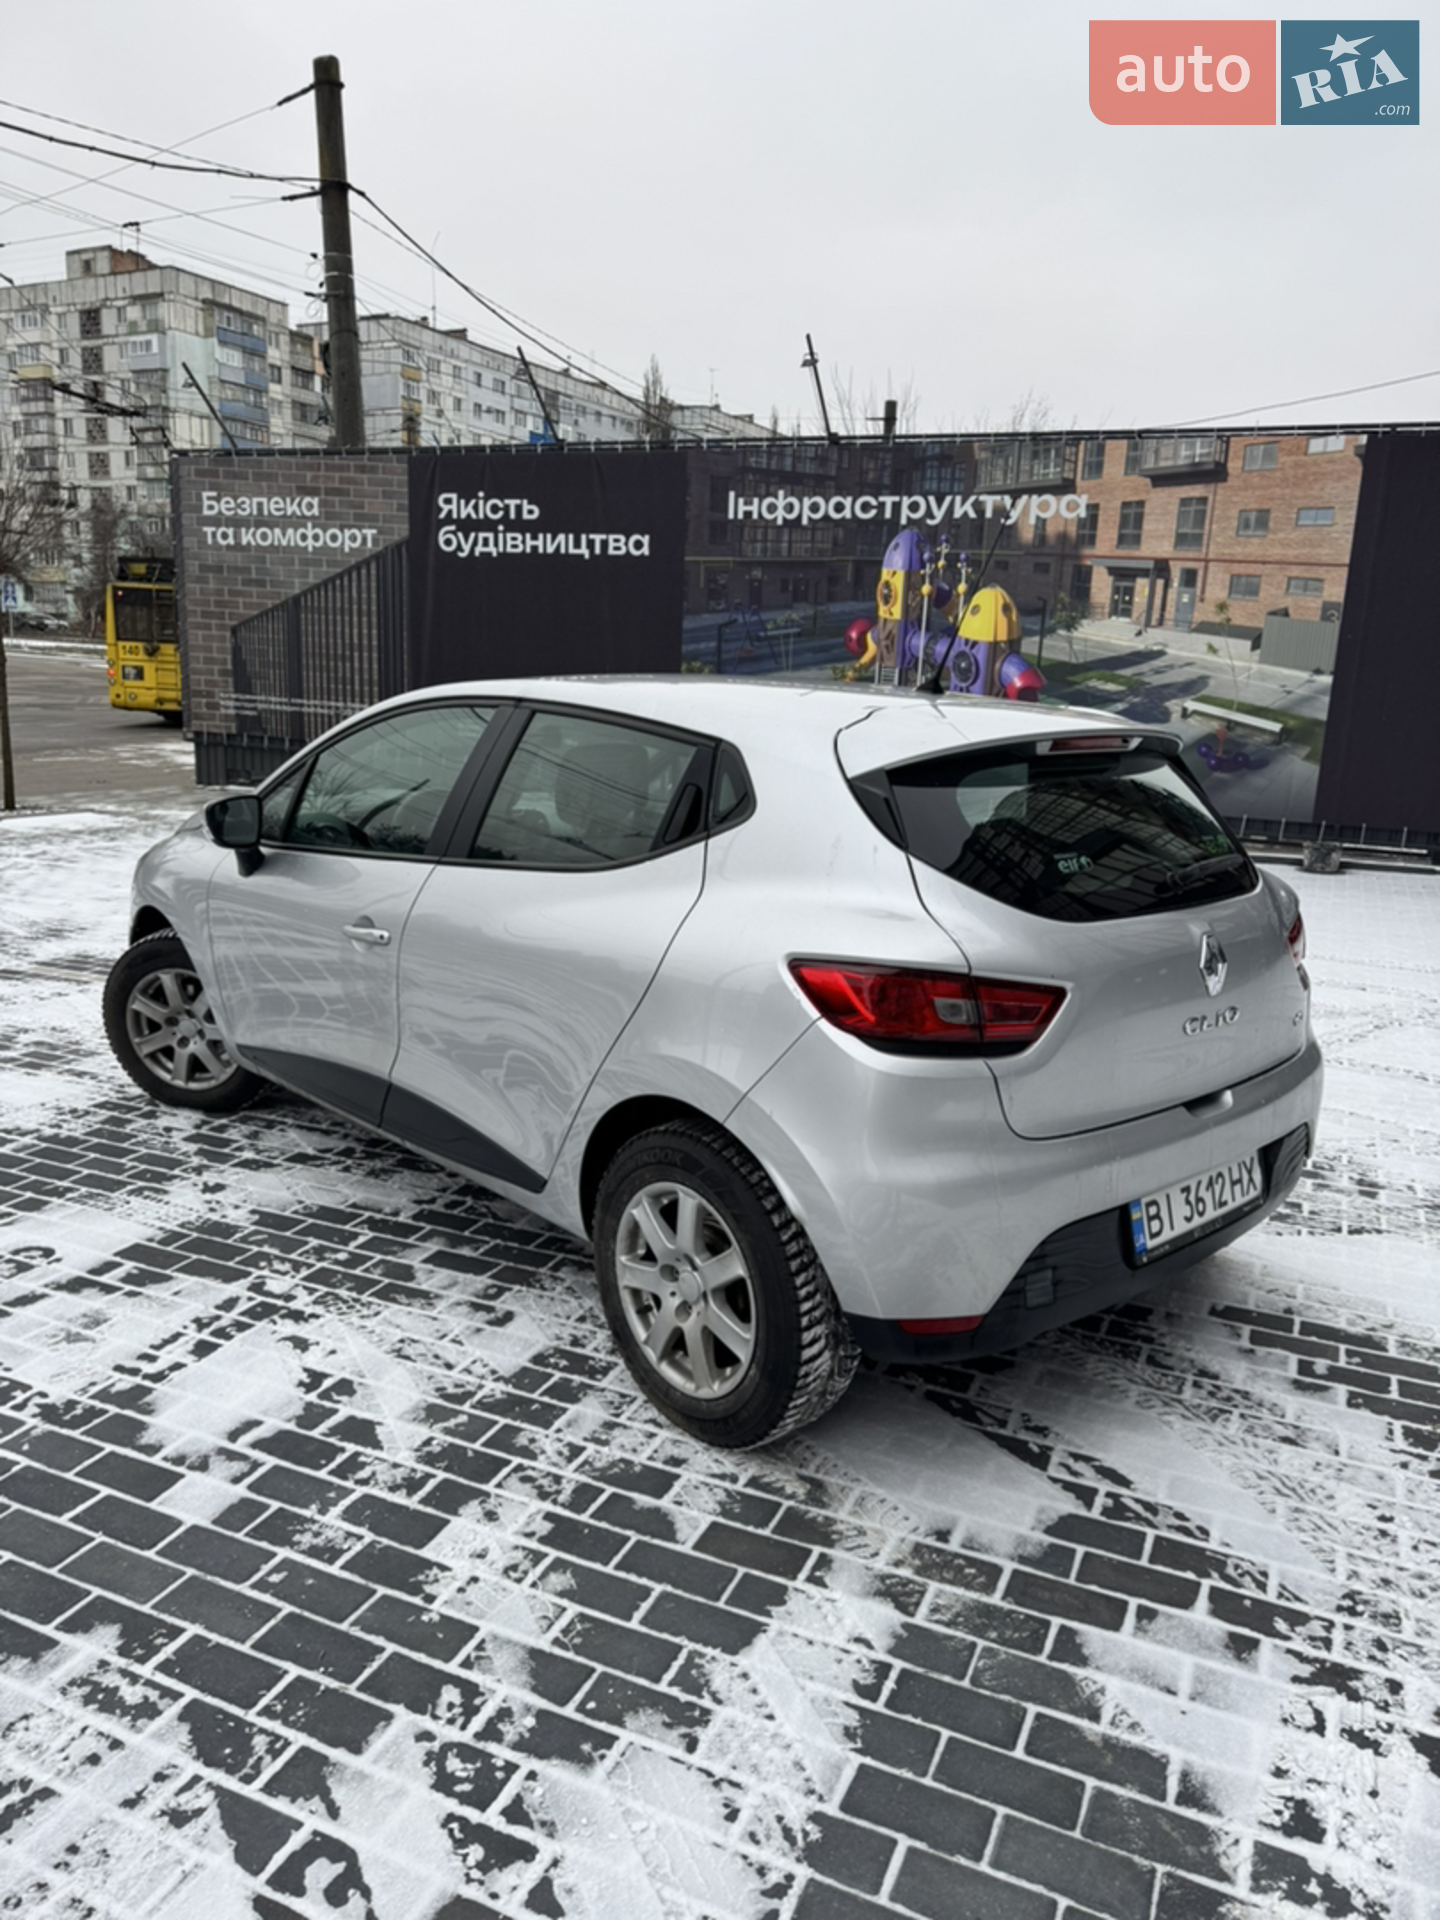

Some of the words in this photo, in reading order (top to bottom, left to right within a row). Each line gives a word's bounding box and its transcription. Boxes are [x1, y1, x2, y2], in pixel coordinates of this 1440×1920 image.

[201, 491, 319, 517] Безпека
[437, 491, 540, 520] Якість
[727, 489, 1089, 526] Інфраструктура
[203, 526, 234, 546] та
[241, 523, 377, 553] комфорт
[437, 525, 650, 560] будівництва
[1182, 1005, 1240, 1036] CLIO
